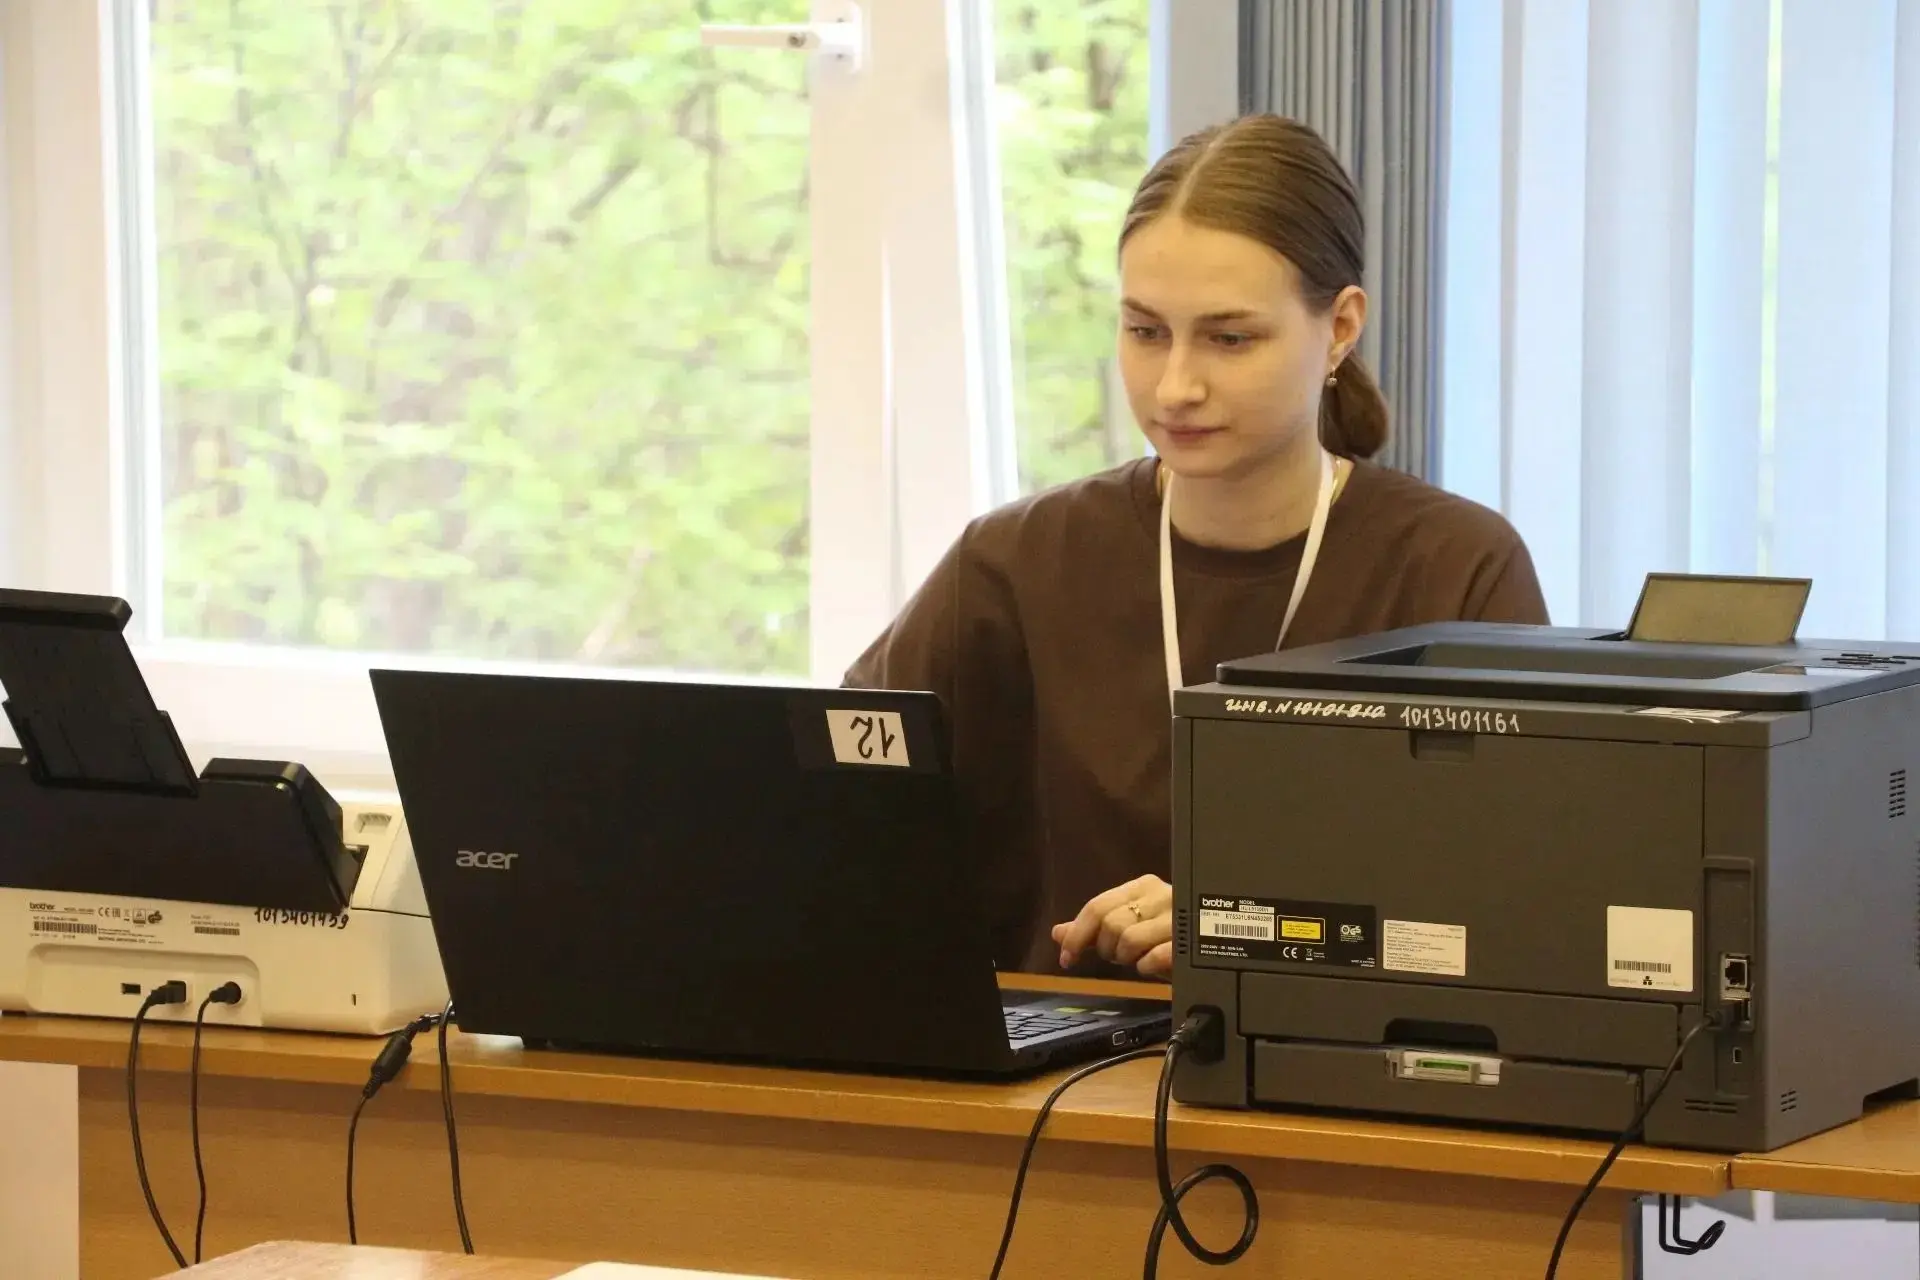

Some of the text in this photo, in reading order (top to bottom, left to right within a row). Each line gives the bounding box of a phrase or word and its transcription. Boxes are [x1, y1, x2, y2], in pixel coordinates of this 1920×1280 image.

[1400, 705, 1520, 734] 1013401161
[456, 850, 519, 870] acer
[29, 902, 55, 911] brother
[1202, 898, 1235, 909] brother
